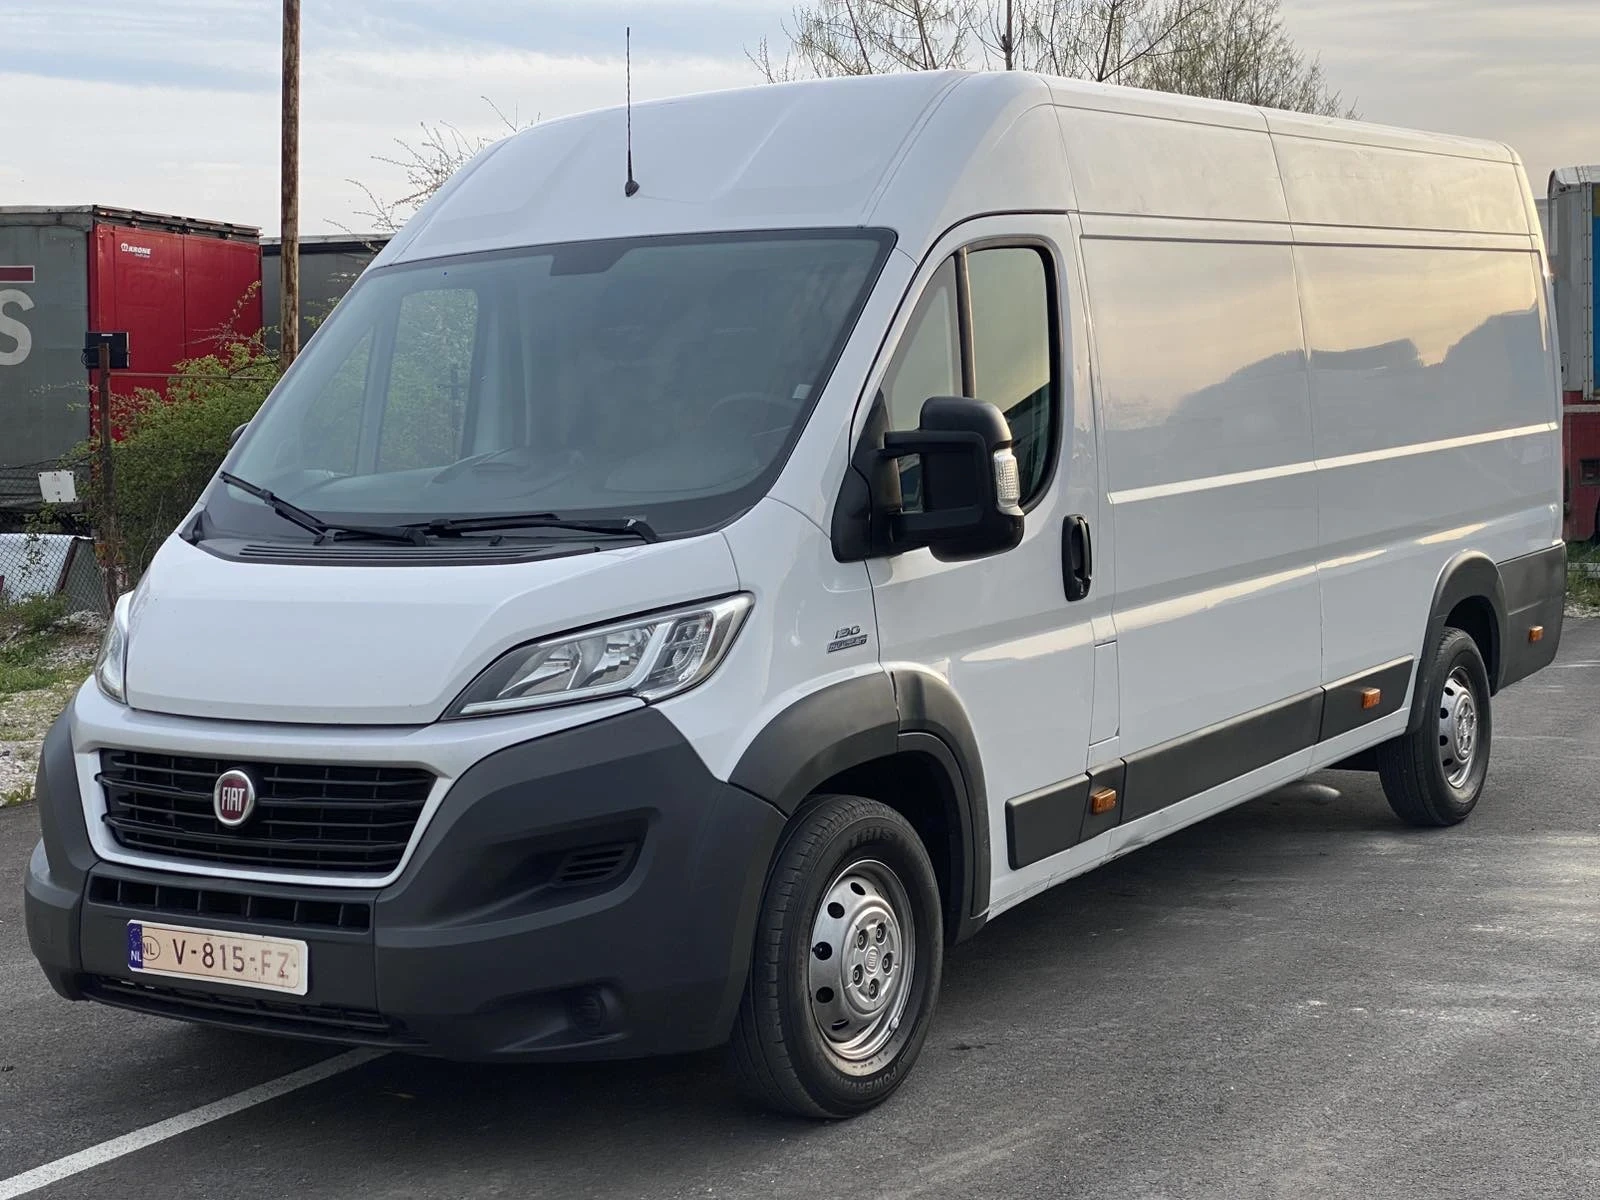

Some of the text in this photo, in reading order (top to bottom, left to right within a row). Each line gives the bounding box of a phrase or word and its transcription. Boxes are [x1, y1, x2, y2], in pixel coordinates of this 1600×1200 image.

[0, 288, 35, 366] S
[221, 786, 246, 812] FIAT
[130, 949, 142, 962] NL
[143, 942, 156, 956] NL
[172, 938, 289, 980] V-815-FZ
